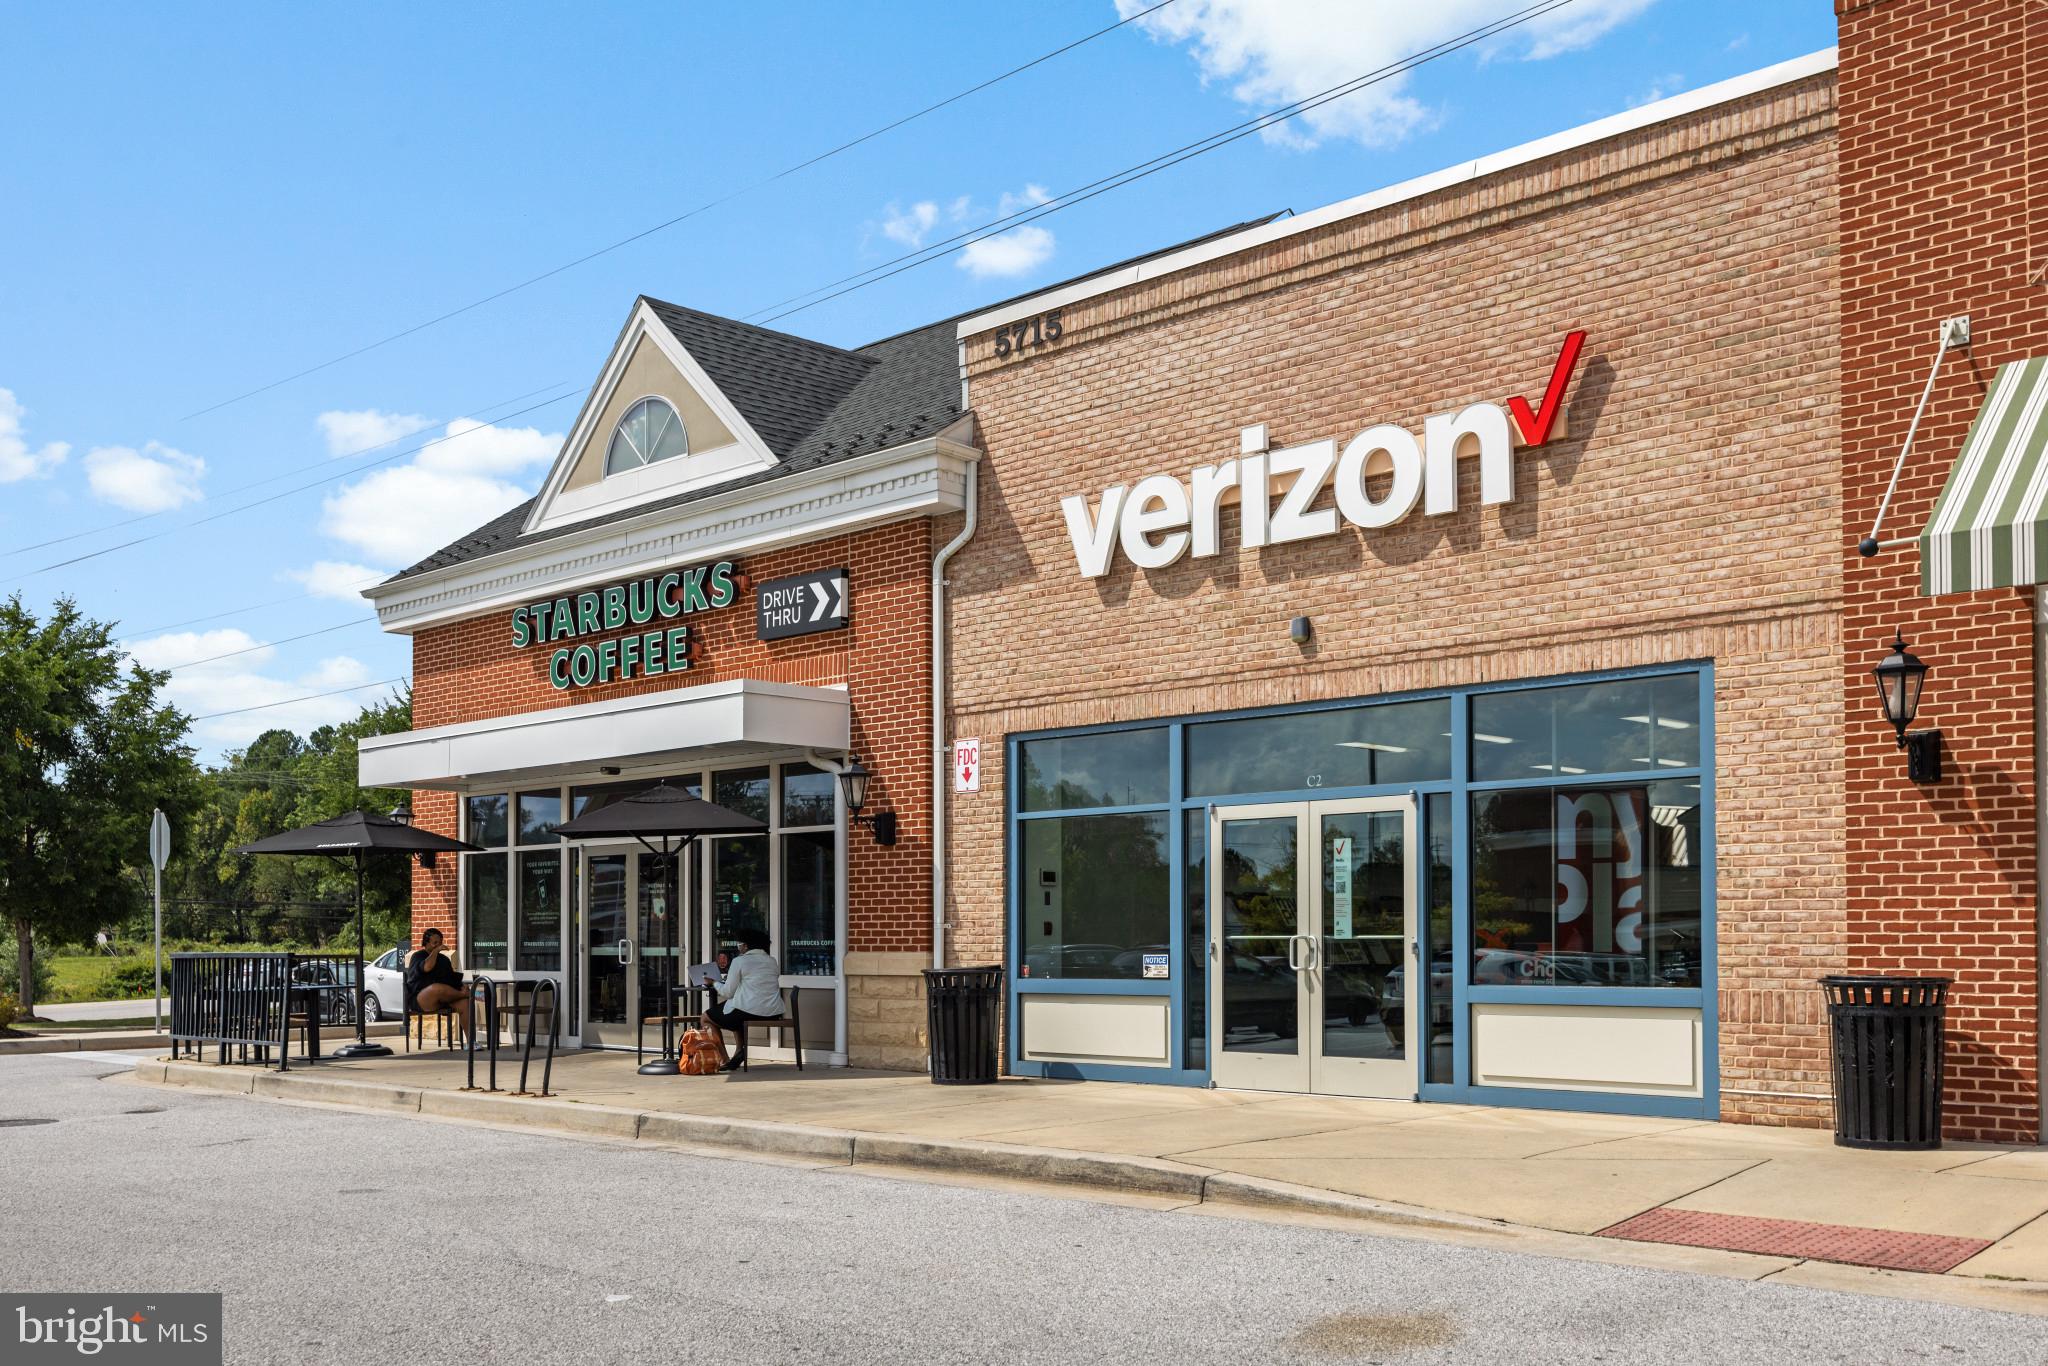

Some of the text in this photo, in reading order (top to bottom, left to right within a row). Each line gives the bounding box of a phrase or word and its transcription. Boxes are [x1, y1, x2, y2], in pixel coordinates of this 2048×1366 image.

[994, 311, 1063, 357] 5715
[1060, 401, 1515, 579] verizon
[511, 561, 735, 648] STARBUCKS
[763, 585, 804, 610] DRIVE
[763, 606, 802, 629] THRU
[549, 626, 688, 690] COFFEE
[957, 747, 977, 766] FDC
[1306, 774, 1322, 787] C2
[1144, 956, 1167, 964] NOTICE
